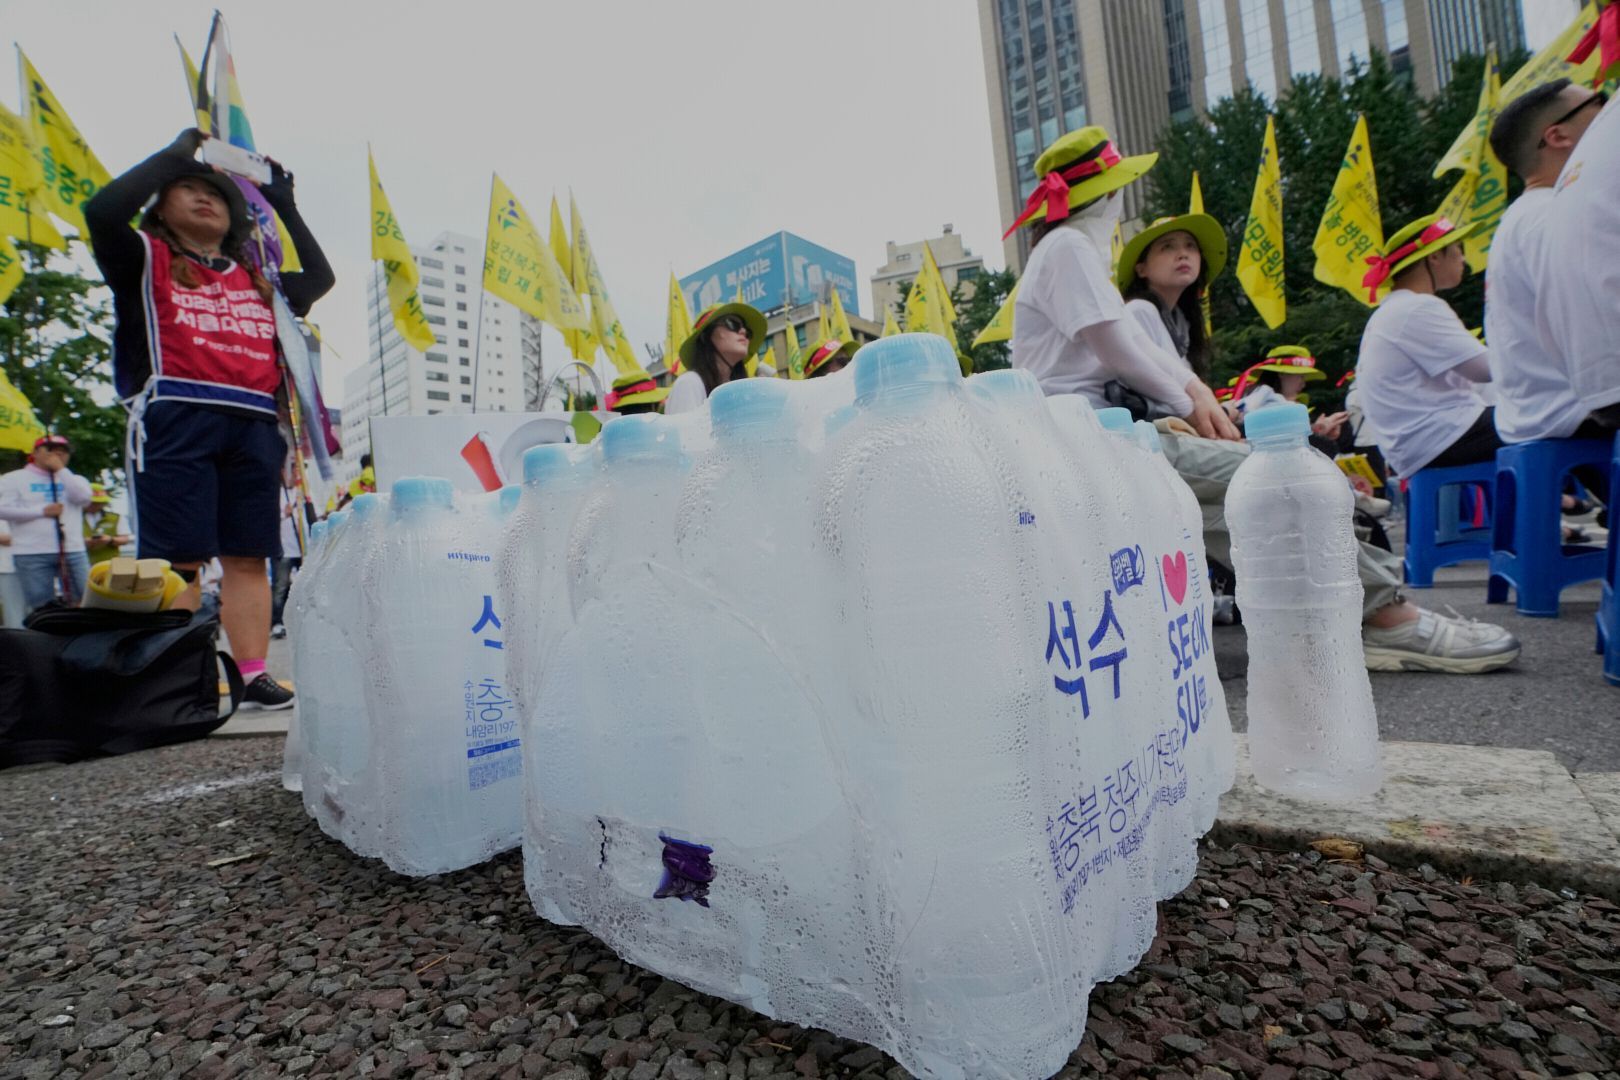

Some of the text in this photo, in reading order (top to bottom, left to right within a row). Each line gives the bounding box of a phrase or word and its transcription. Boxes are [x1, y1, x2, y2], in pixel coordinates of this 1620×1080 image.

[1045, 590, 1128, 720] 석수
[1168, 602, 1209, 681] SEOK
[1177, 672, 1201, 750] SU
[1058, 785, 1101, 872] 충북
[1103, 758, 1149, 833] 청주시
